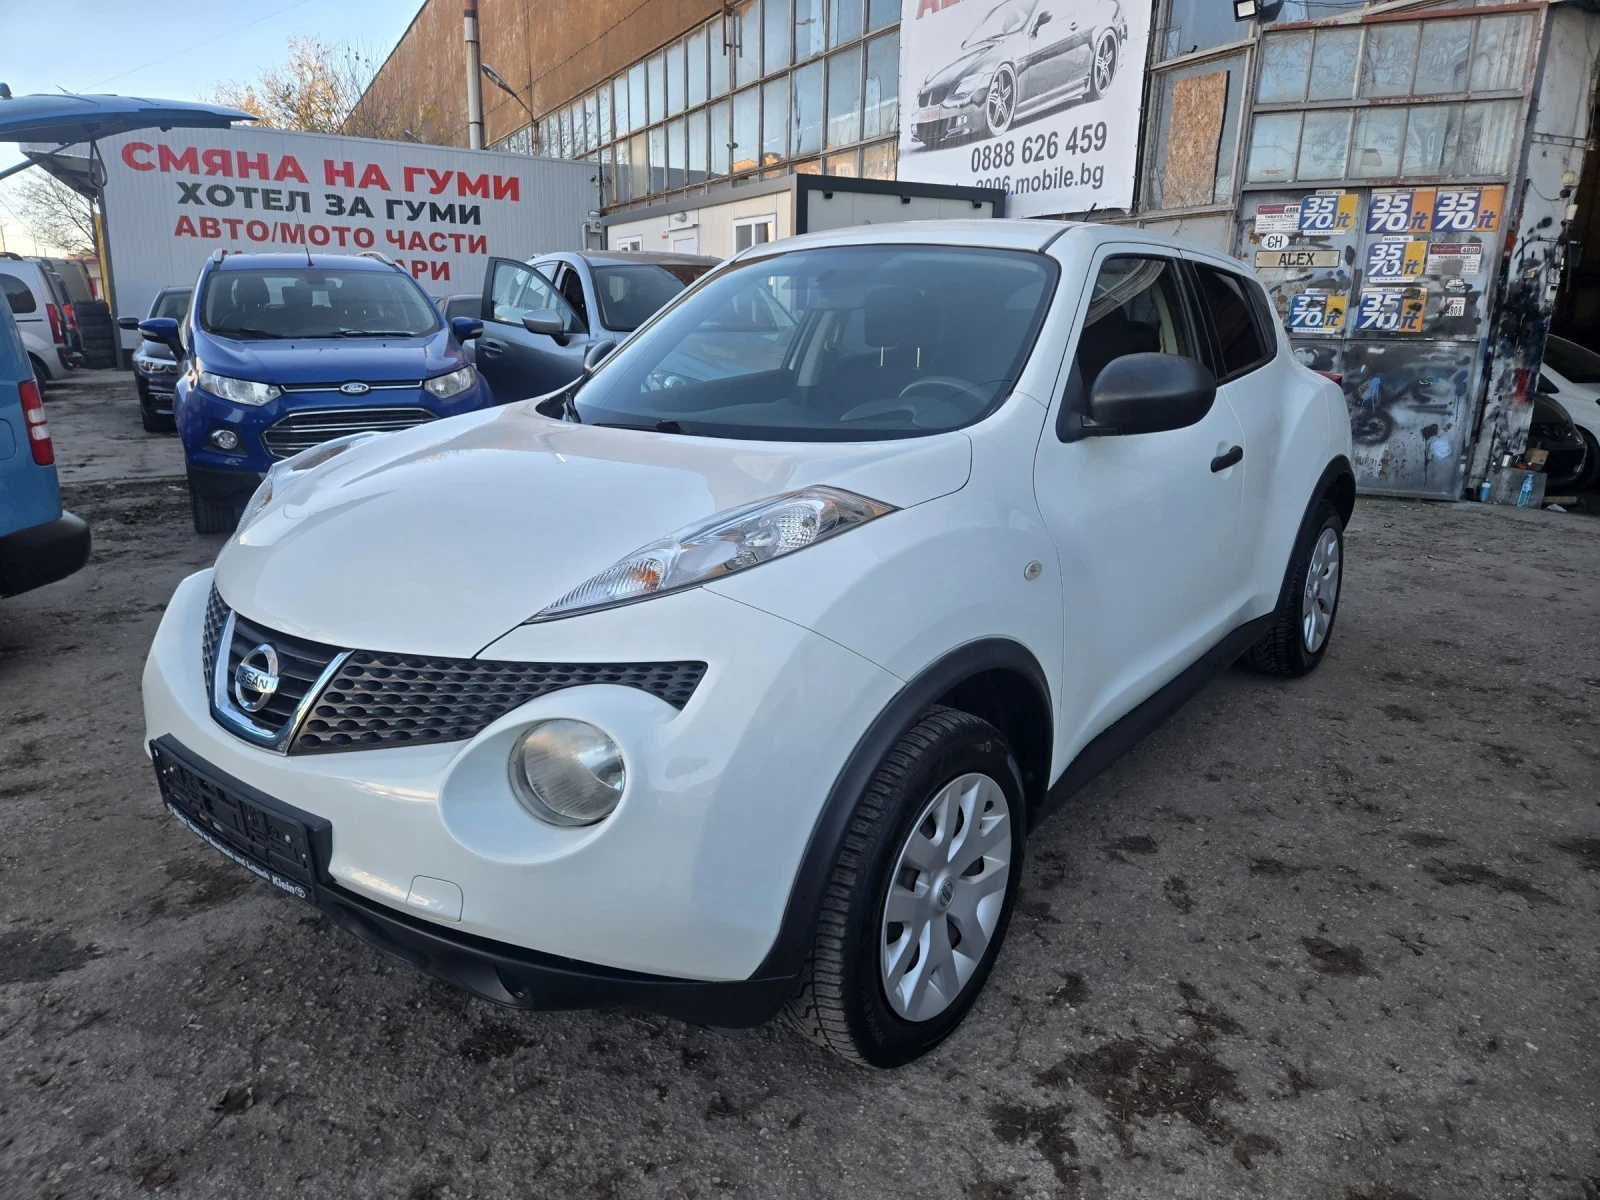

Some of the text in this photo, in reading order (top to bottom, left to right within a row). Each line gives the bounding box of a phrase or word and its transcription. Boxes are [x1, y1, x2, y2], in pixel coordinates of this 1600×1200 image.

[971, 121, 1107, 173] 0888 626 459
[121, 141, 520, 202] СМЯНА НА ГУМИ
[176, 181, 481, 226] ХОТЕЛ ЗА ГУМИ
[1304, 197, 1337, 213] 35
[1372, 194, 1411, 213] 35
[1437, 192, 1479, 211] 35
[174, 215, 488, 255] АВТО/МОТО ЧАСТИ
[1278, 252, 1315, 265] ALEX
[1370, 244, 1404, 260] 35
[271, 874, 295, 894] Klein
